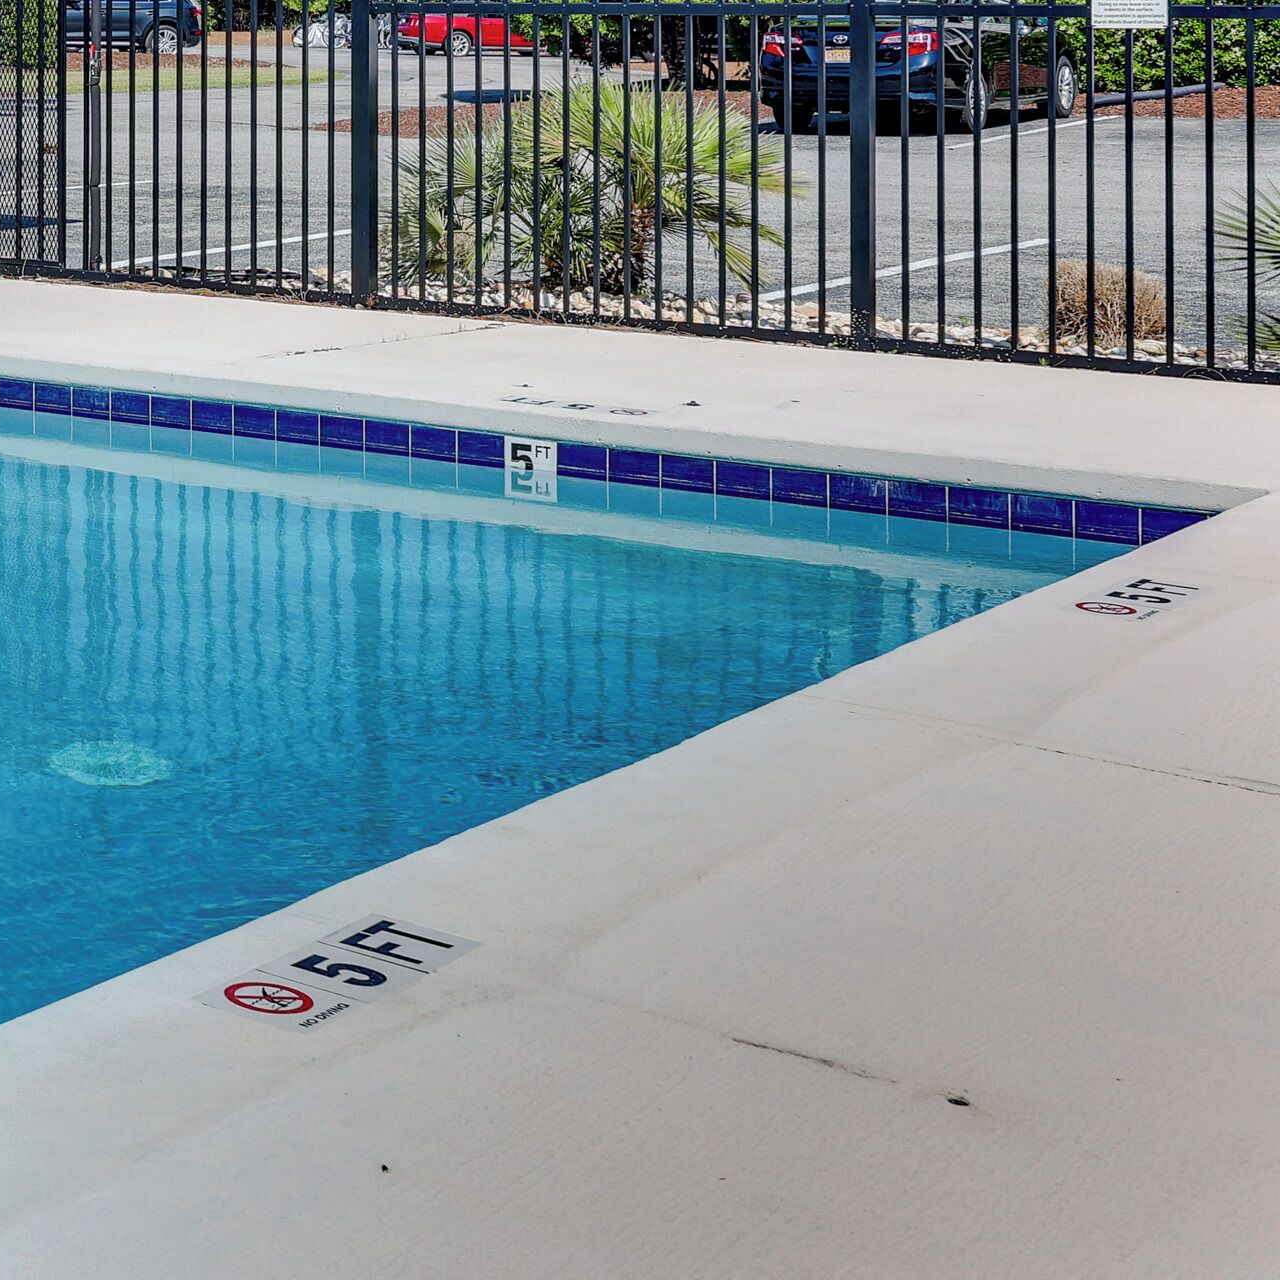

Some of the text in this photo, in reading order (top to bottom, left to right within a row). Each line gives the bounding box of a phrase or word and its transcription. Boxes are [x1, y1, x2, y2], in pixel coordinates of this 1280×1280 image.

[511, 442, 551, 471] 5 FT
[1105, 579, 1199, 603] 5 FT
[290, 919, 455, 987] 5 FT
[299, 1002, 350, 1029] NO DIVING
